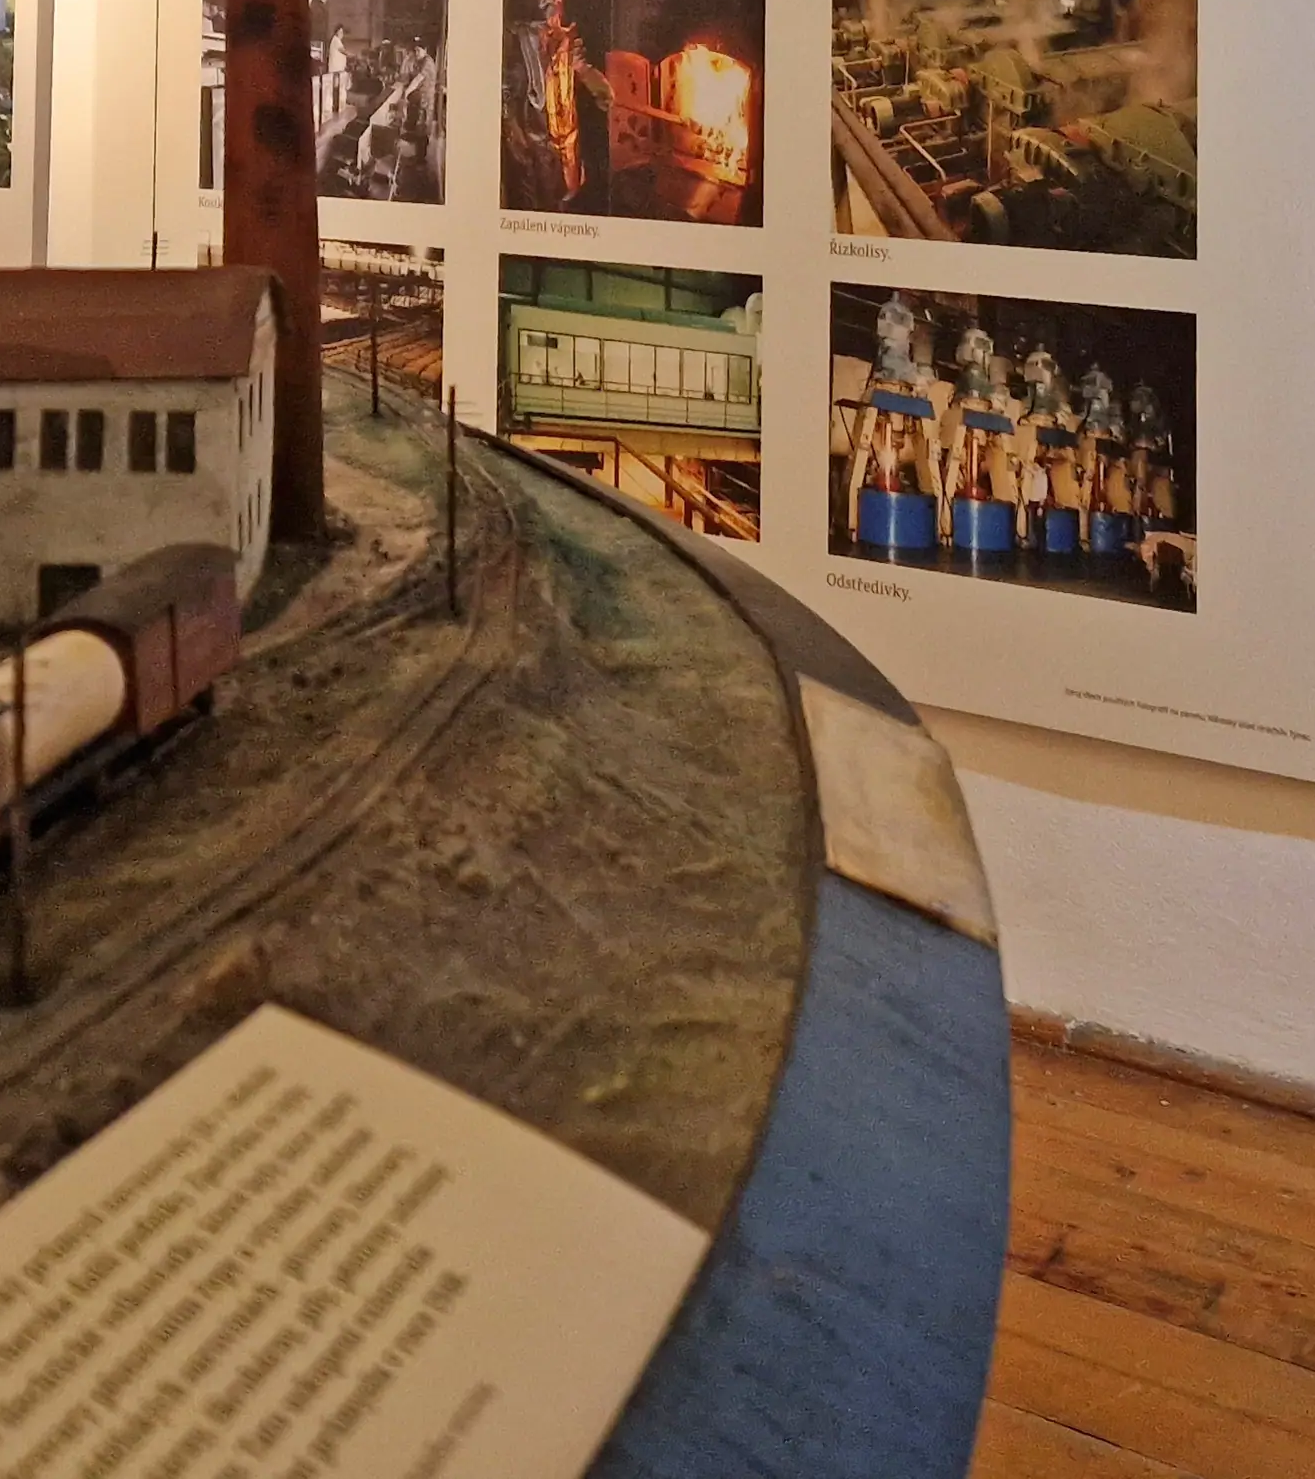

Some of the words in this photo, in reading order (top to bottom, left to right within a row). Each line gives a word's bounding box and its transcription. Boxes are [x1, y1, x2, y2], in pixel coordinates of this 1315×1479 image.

[500, 217, 547, 234] Zapálení
[551, 220, 600, 238] vápenky.
[829, 239, 891, 263] Řízkolisy.
[826, 572, 912, 602] Odstředivky.
